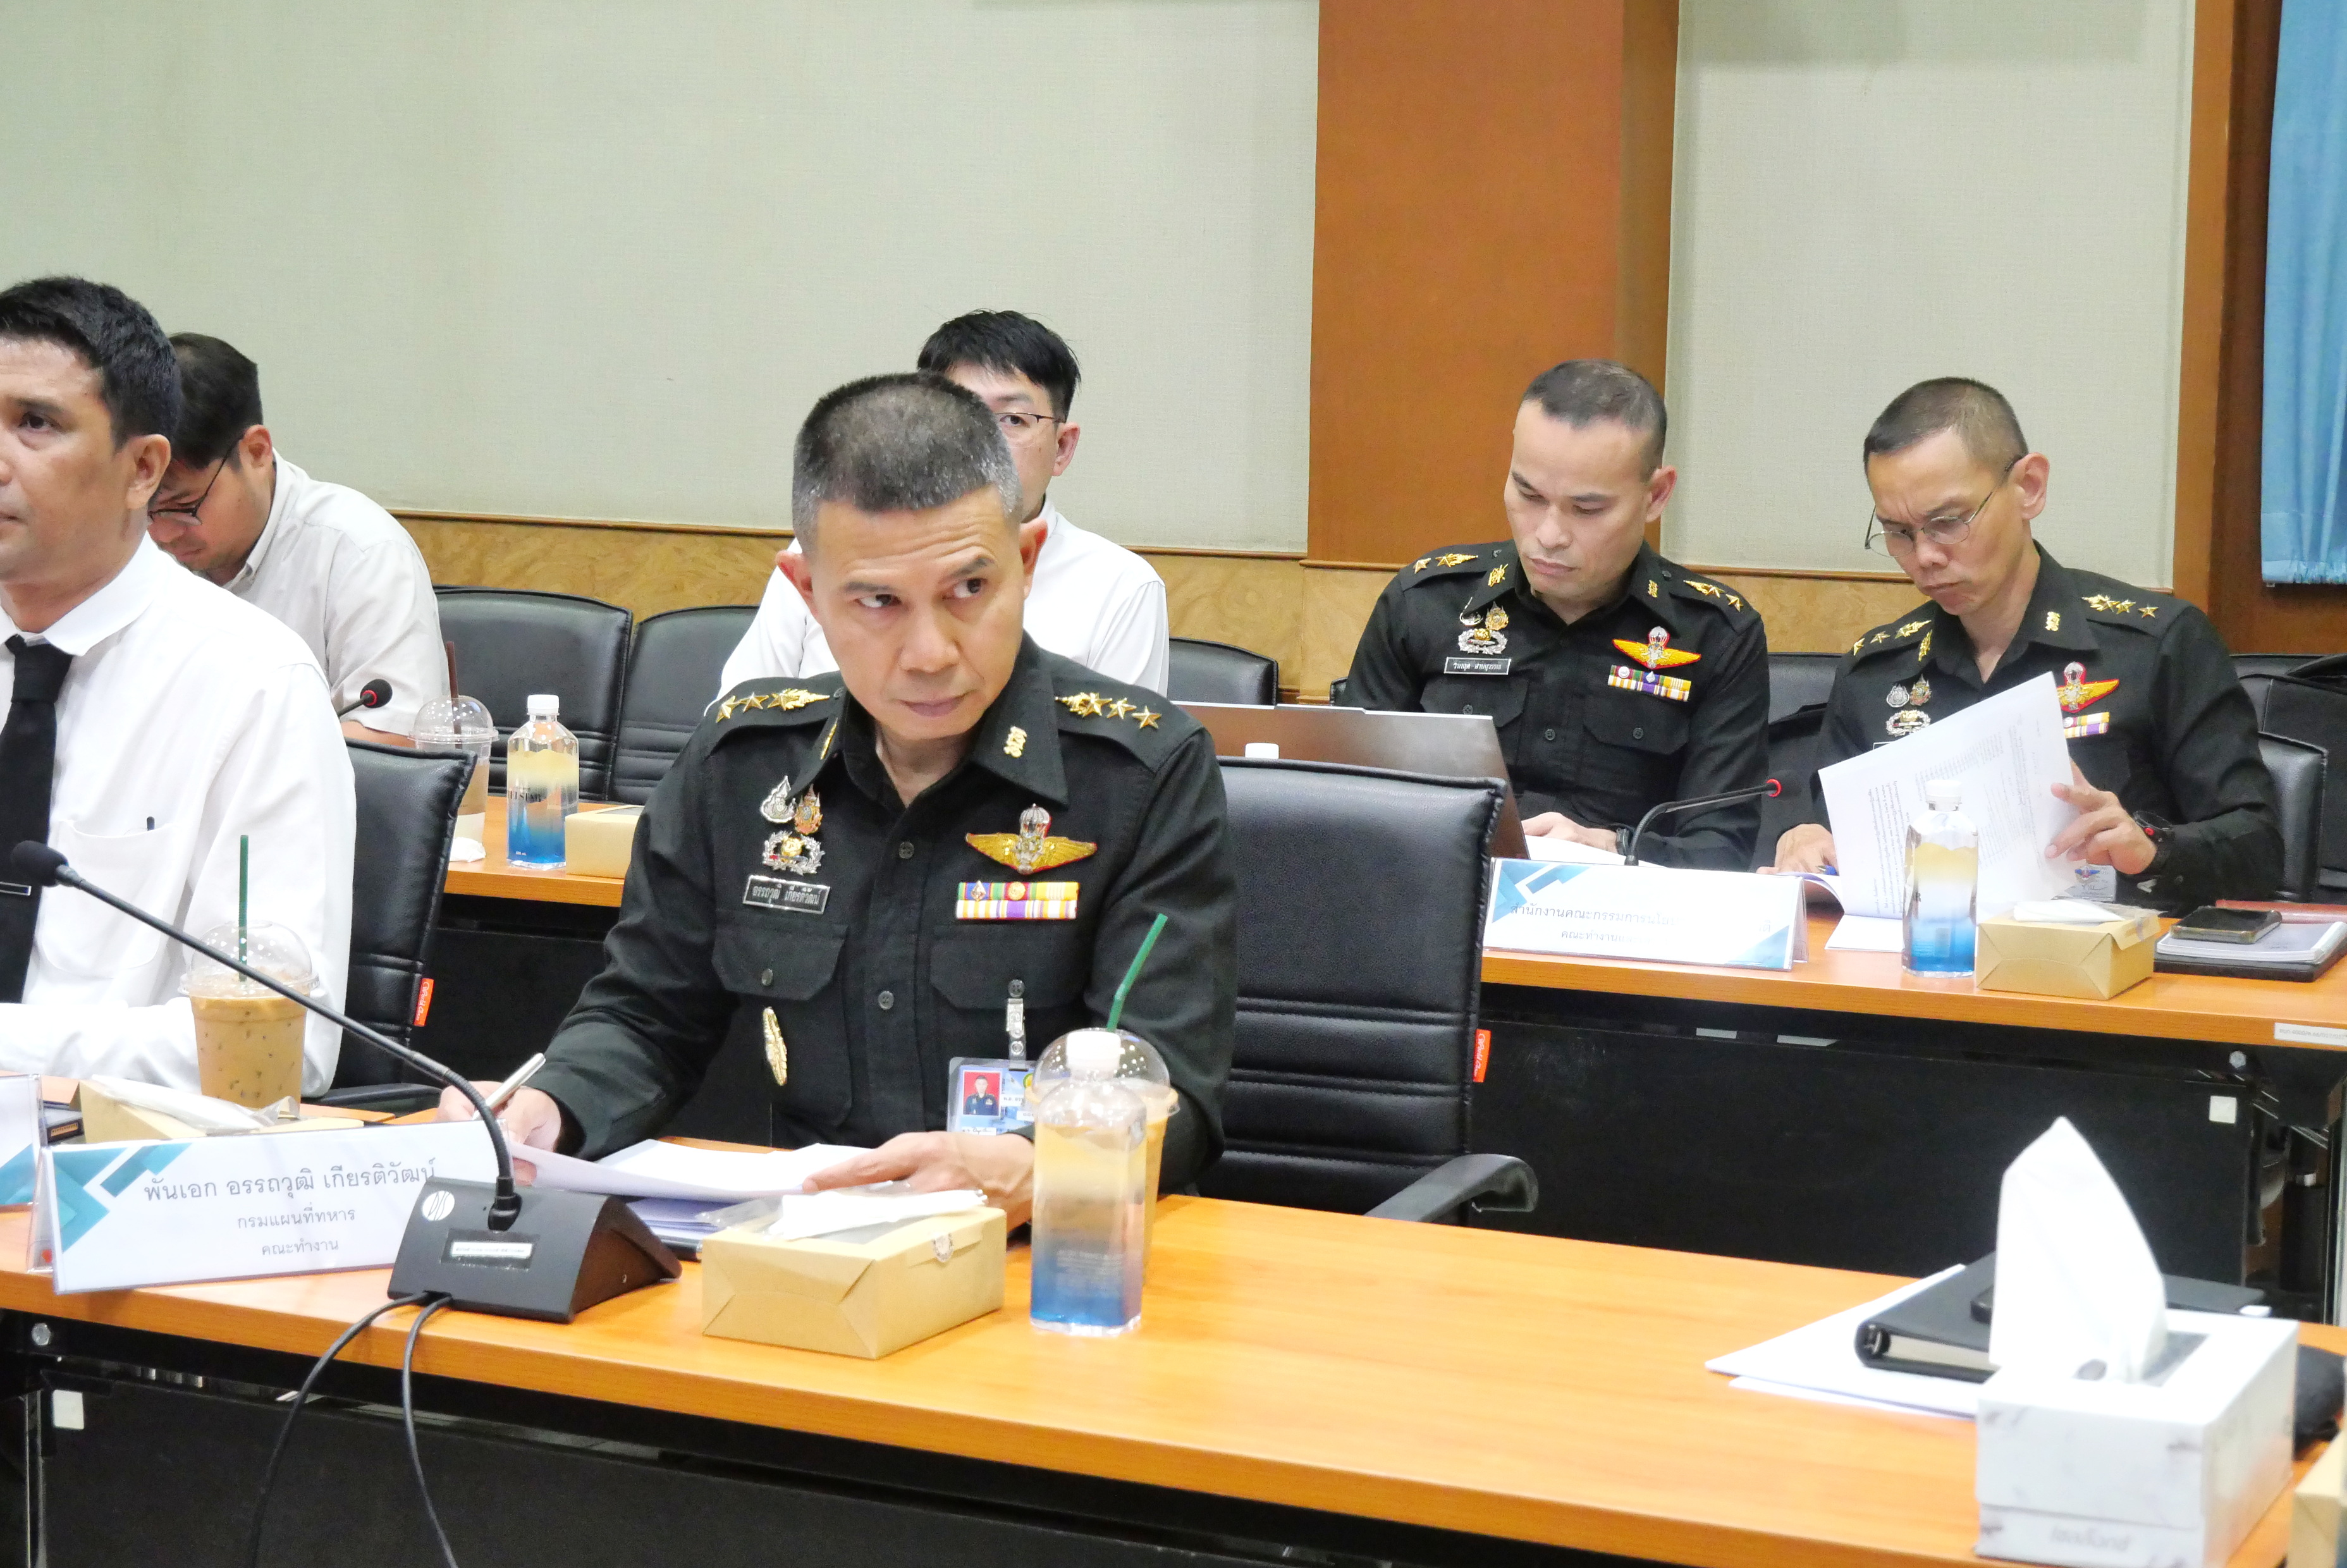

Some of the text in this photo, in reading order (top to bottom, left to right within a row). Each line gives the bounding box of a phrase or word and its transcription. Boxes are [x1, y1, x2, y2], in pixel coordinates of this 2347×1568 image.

[144, 1157, 436, 1201] พันเอก อรรถวุฒิ เกียรติวัฒน์
[237, 1201, 356, 1228] กรมแผนที่ทหาร
[262, 1237, 340, 1256] คณะทำงาน
